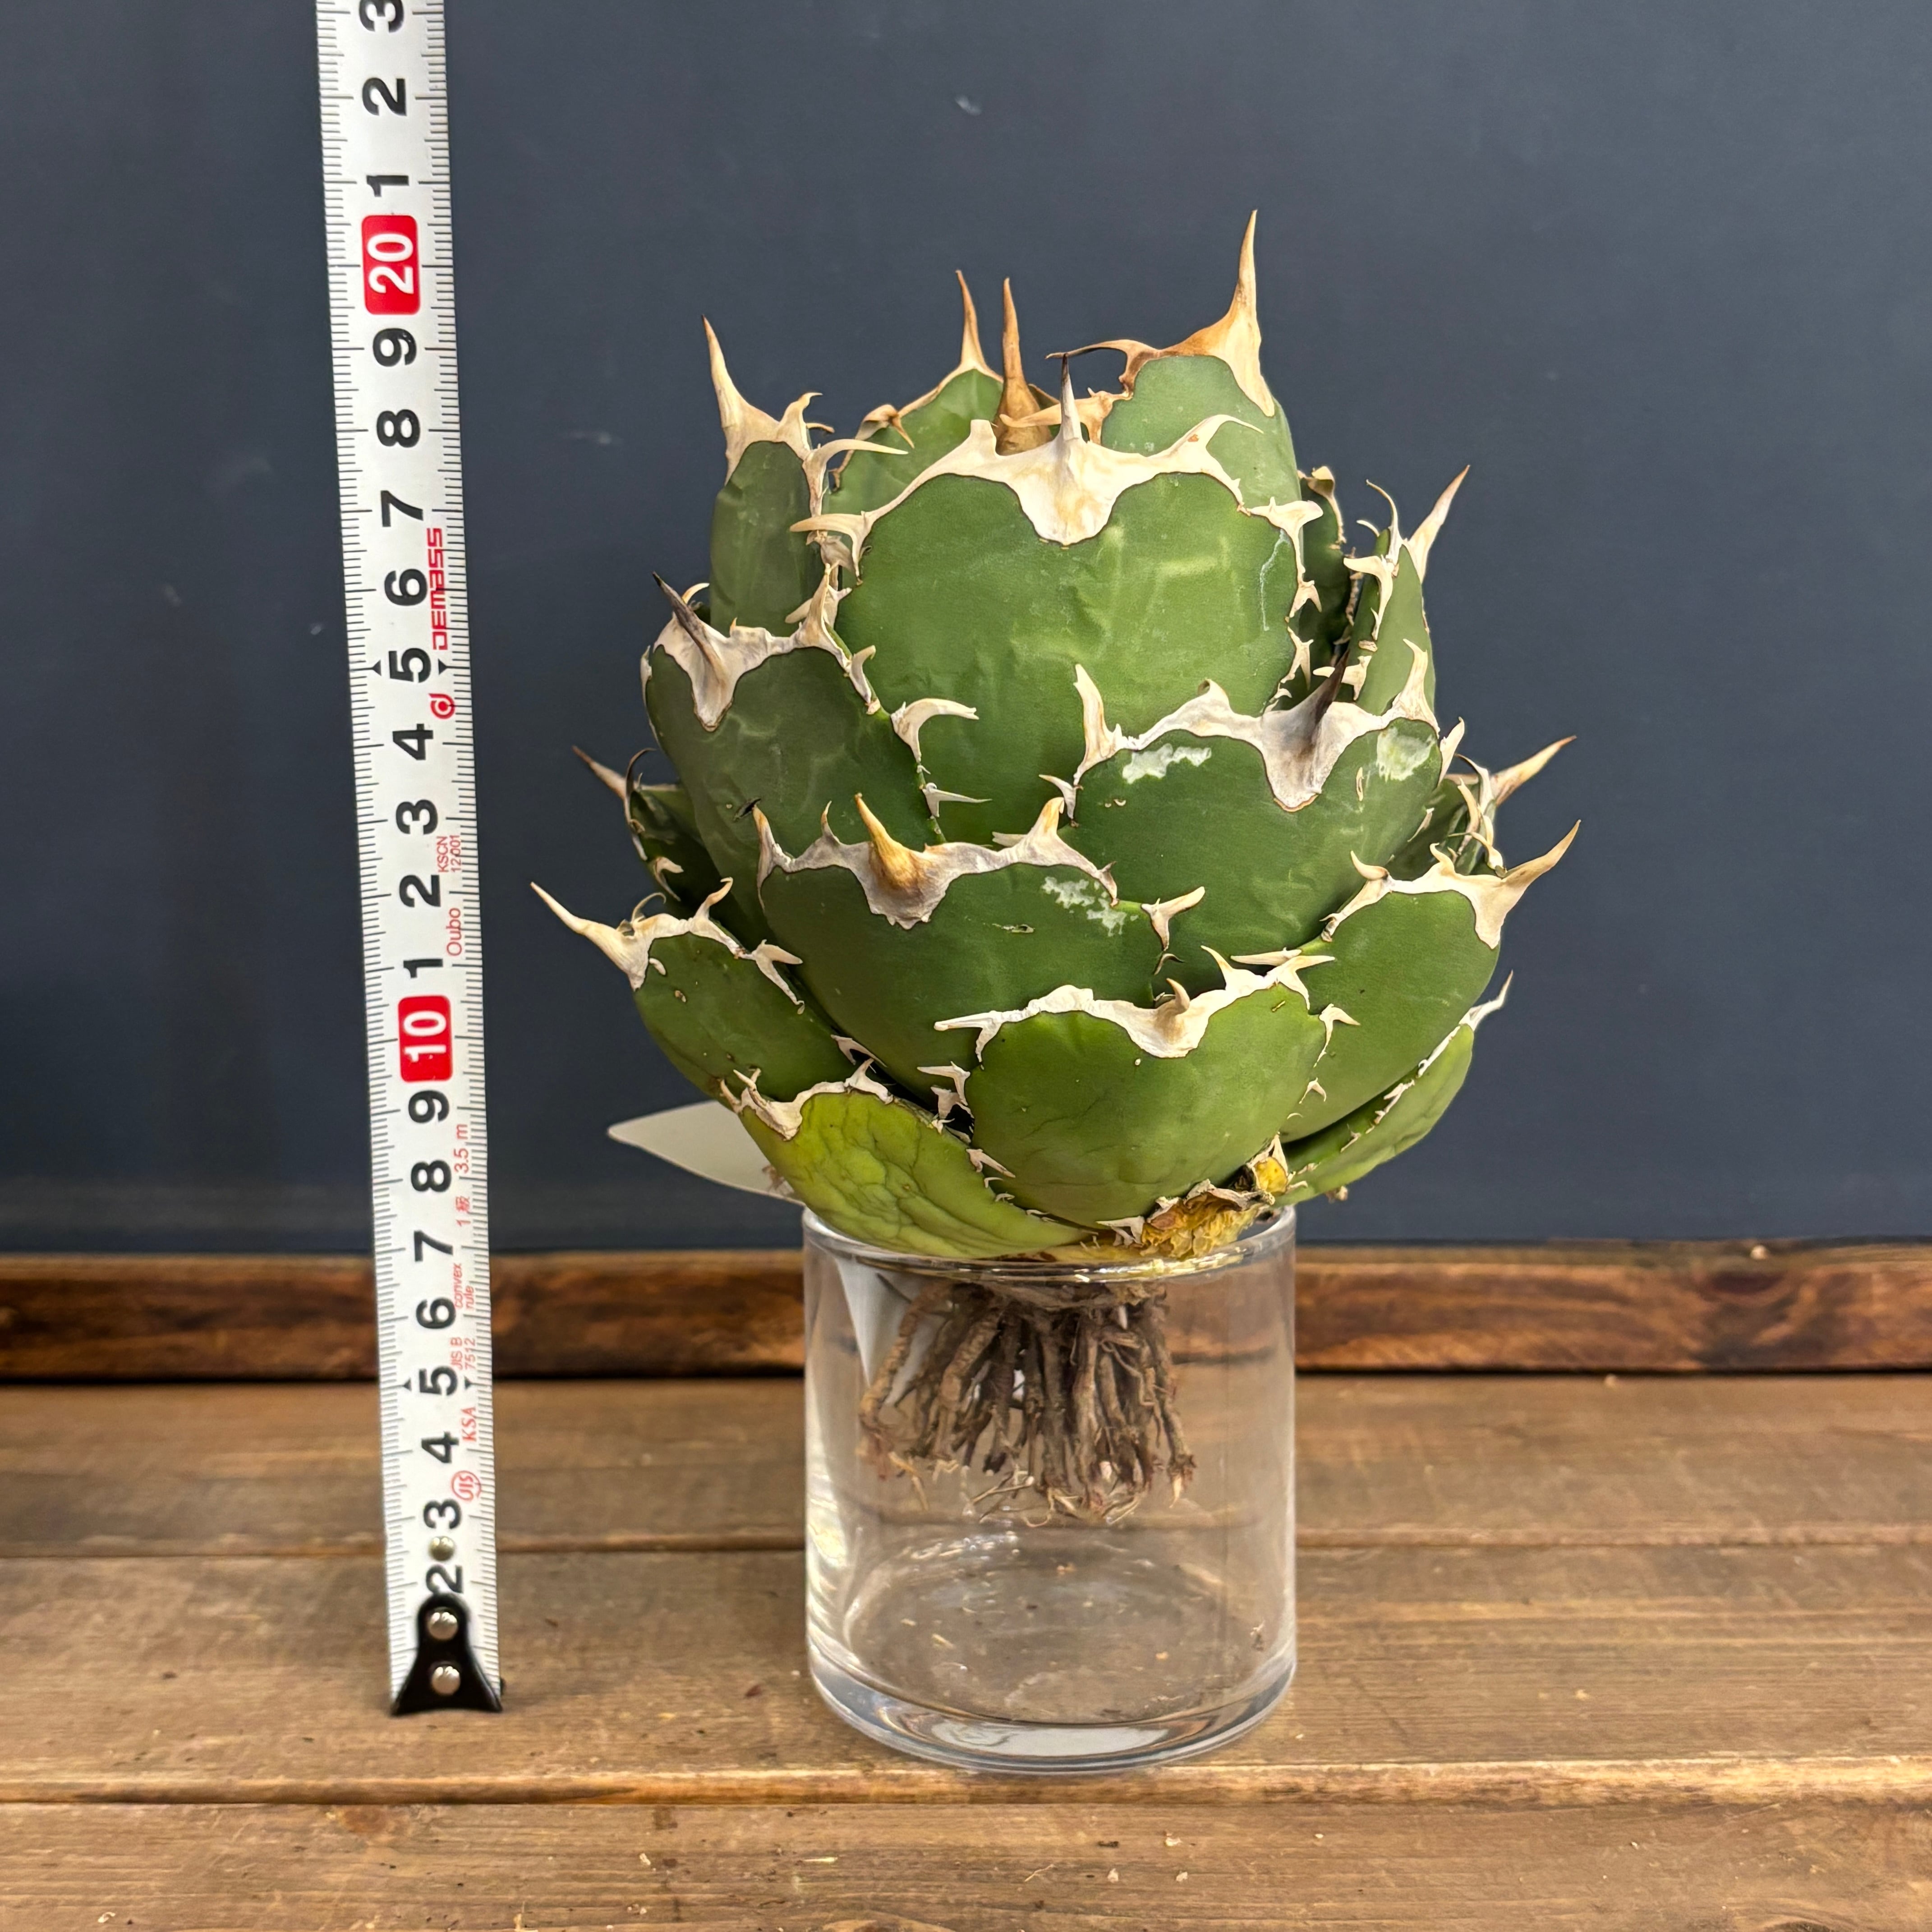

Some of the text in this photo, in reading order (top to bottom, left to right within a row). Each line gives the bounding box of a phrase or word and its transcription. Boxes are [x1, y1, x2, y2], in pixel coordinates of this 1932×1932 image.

[359, 0, 404, 33] 3
[362, 78, 407, 116] 2
[366, 175, 409, 197] 1
[367, 233, 414, 294] 20
[373, 328, 417, 367] 9
[377, 409, 420, 448] 8
[380, 490, 423, 527] 7
[384, 569, 428, 606] 6
[388, 648, 431, 683] 5
[392, 723, 433, 760] 4
[396, 799, 438, 834] 3
[436, 836, 449, 873] KSCN
[399, 874, 441, 907] 2
[446, 907, 462, 957] Oubo
[403, 958, 443, 978] 1
[403, 1010, 446, 1062] 10
[408, 1090, 450, 1123] 9
[411, 1160, 451, 1192] 8
[414, 1230, 453, 1262] 7
[452, 1263, 463, 1309] convex
[465, 1285, 475, 1310] rule
[416, 1297, 456, 1329] 6
[419, 1366, 458, 1396] 5
[421, 1431, 460, 1464] 4
[423, 1499, 461, 1529] 3
[426, 1564, 464, 1594] 2
